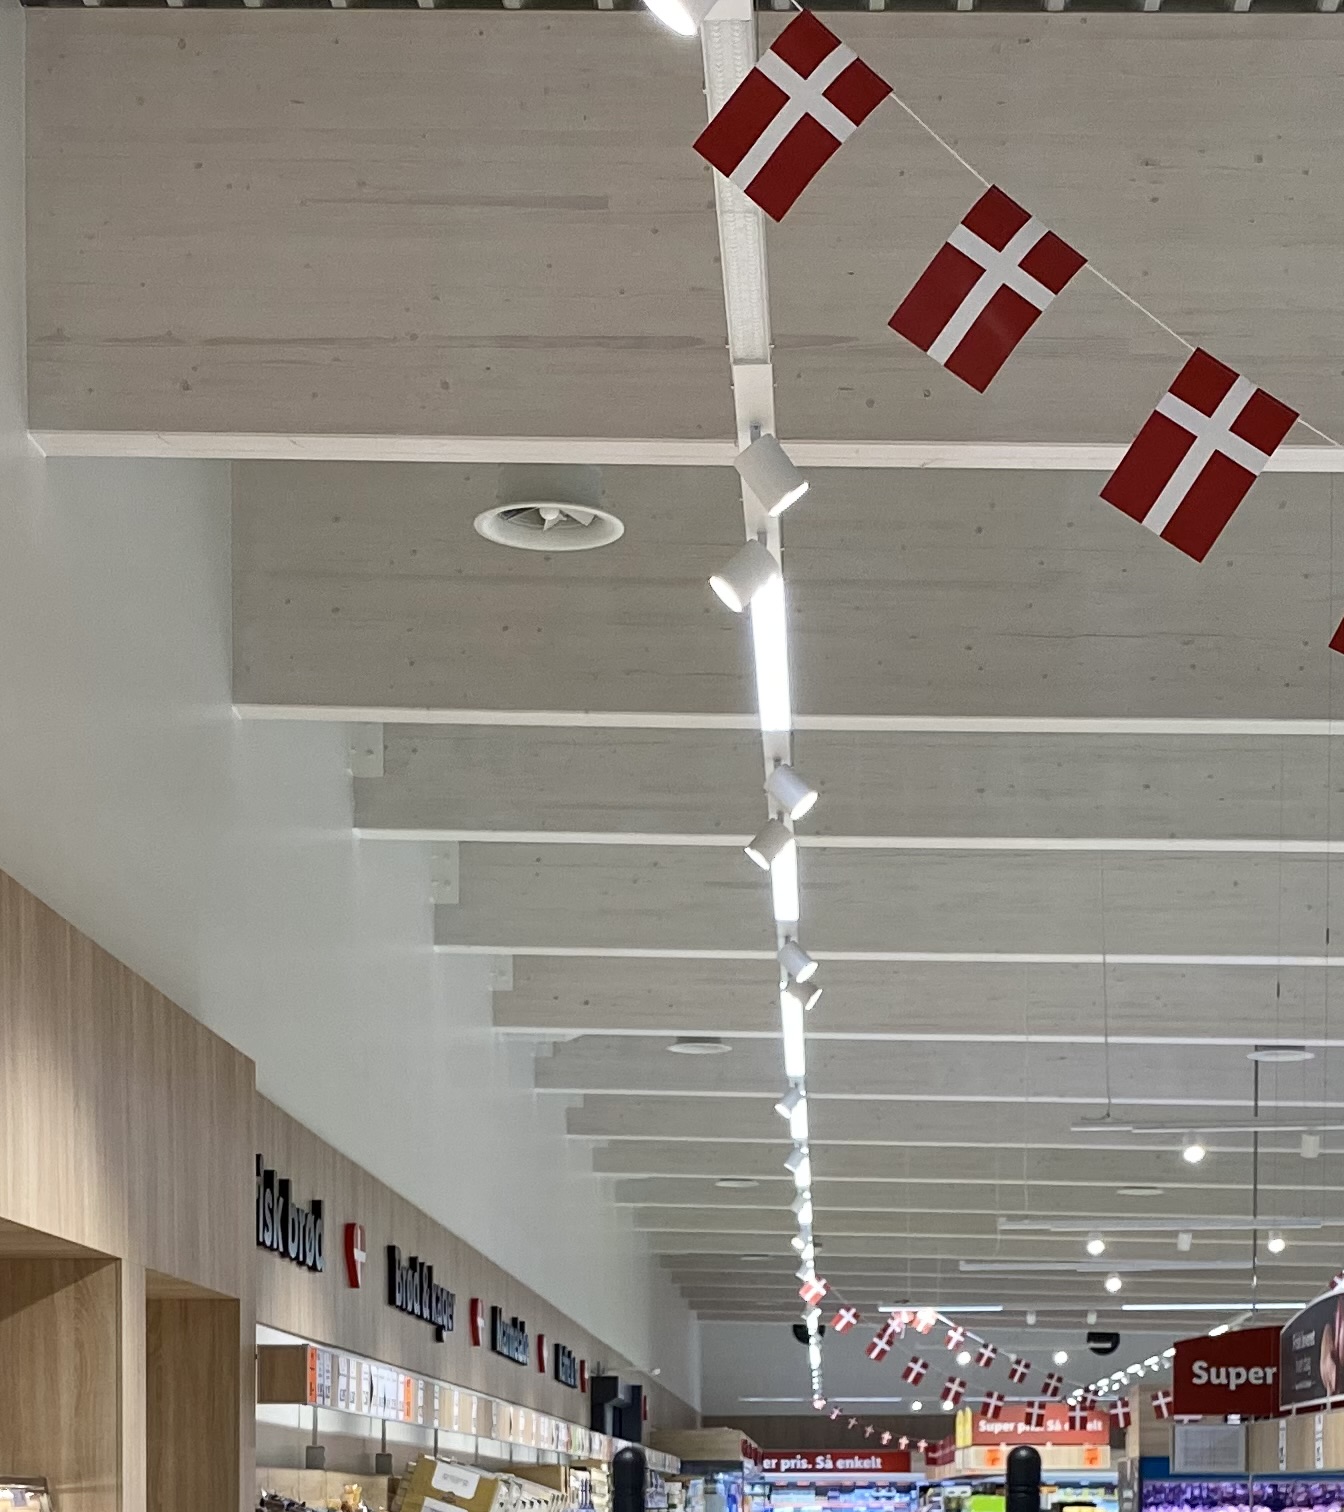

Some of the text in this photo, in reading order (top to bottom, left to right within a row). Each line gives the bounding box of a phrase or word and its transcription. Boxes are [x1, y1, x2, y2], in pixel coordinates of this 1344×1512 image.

[1191, 1361, 1276, 1390] Super
[781, 1454, 812, 1470] pris.
[816, 1451, 833, 1469] Så
[836, 1453, 883, 1469] enkelt
